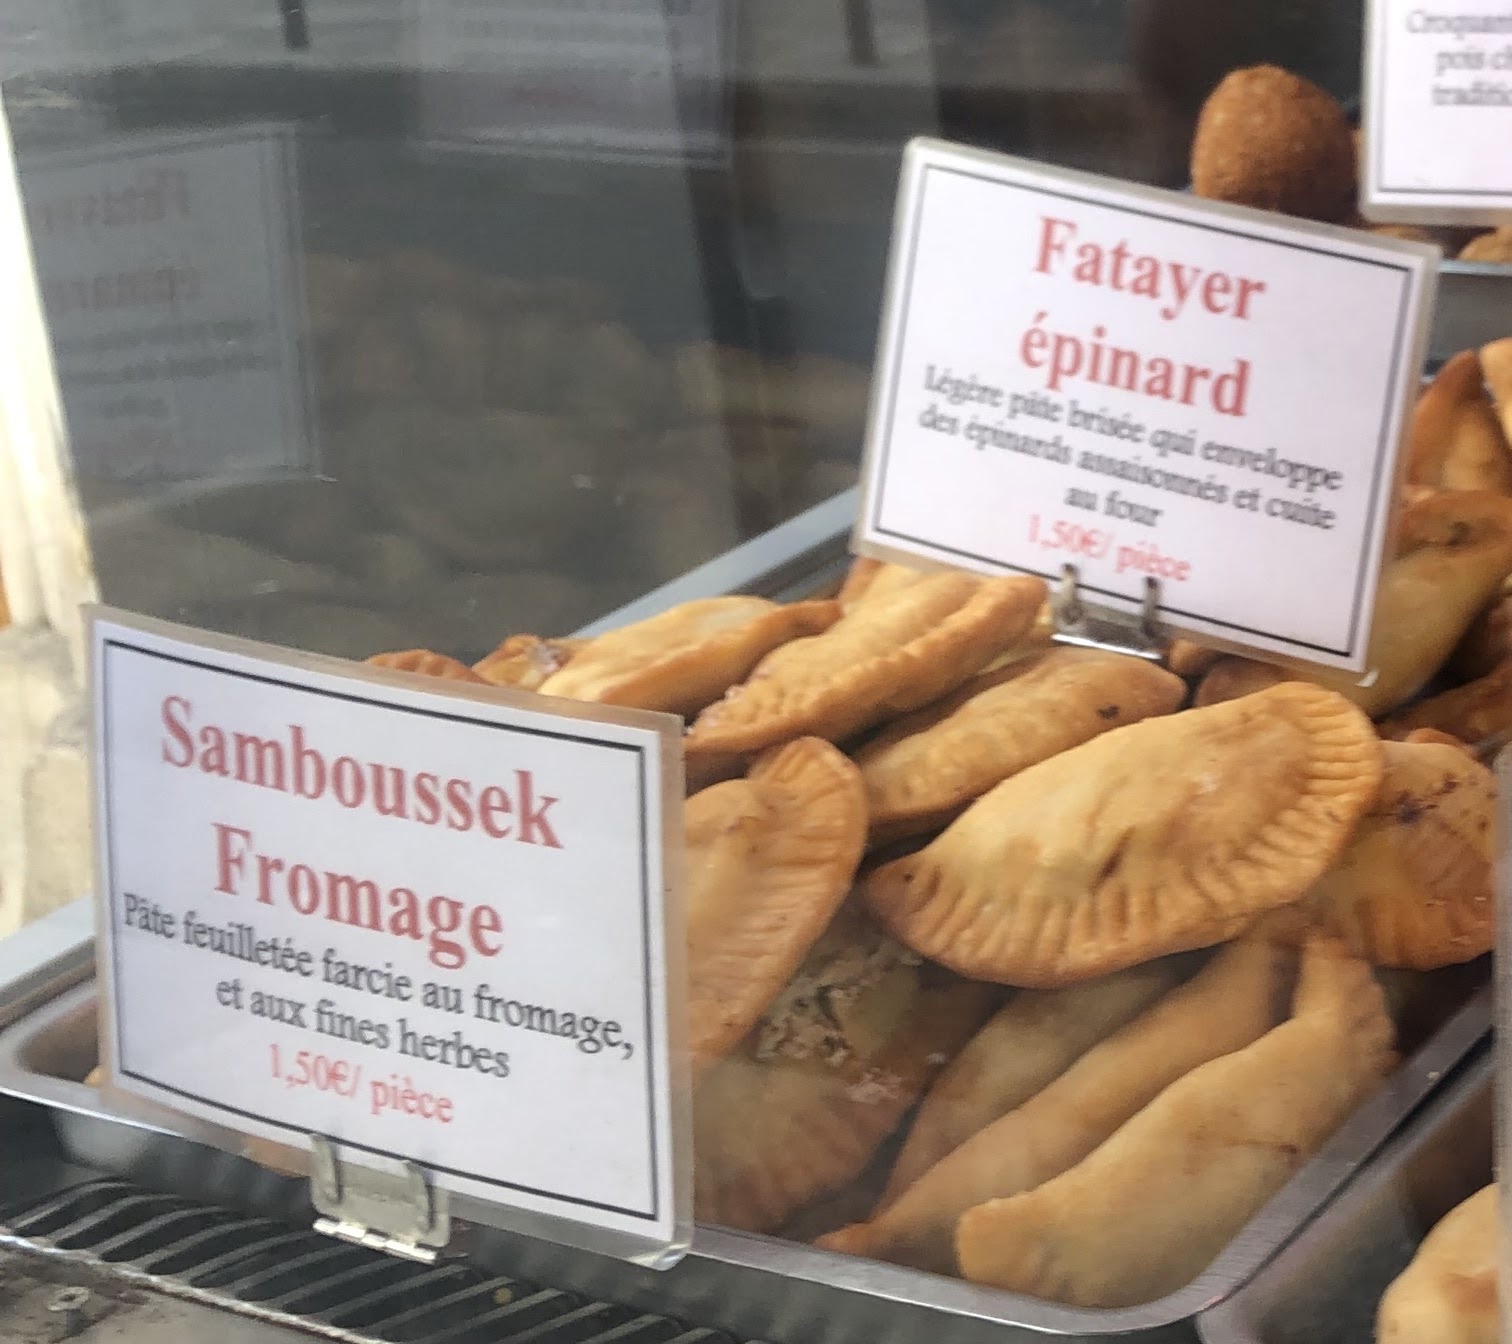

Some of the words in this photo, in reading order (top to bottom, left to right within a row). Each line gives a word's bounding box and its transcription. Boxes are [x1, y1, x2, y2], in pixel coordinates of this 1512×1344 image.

[1033, 215, 1266, 321] Fatayer
[1021, 312, 1251, 417] épinard
[920, 402, 959, 436] des
[965, 419, 1072, 466] épinards
[1232, 486, 1261, 513] et
[1265, 495, 1337, 530] cuite
[923, 363, 1004, 411] Légère
[1009, 393, 1063, 426] pâte
[1068, 398, 1145, 443] brisée
[1149, 425, 1196, 460] qui
[1200, 436, 1343, 493] enveloppe
[1064, 487, 1099, 513] au
[1104, 492, 1164, 529] four
[1116, 539, 1192, 582] pièce
[160, 694, 565, 849] Samboussek
[212, 822, 504, 970] Fromage
[122, 892, 177, 940] Pâte
[183, 906, 315, 977] feuilletée
[322, 947, 411, 1003] farcie
[423, 978, 463, 1013] au
[473, 982, 634, 1061] fromage,
[216, 975, 245, 1011] et
[250, 990, 307, 1030] aux
[314, 998, 390, 1051] fines
[397, 1019, 511, 1079] herbes
[370, 1073, 454, 1124] pièce
